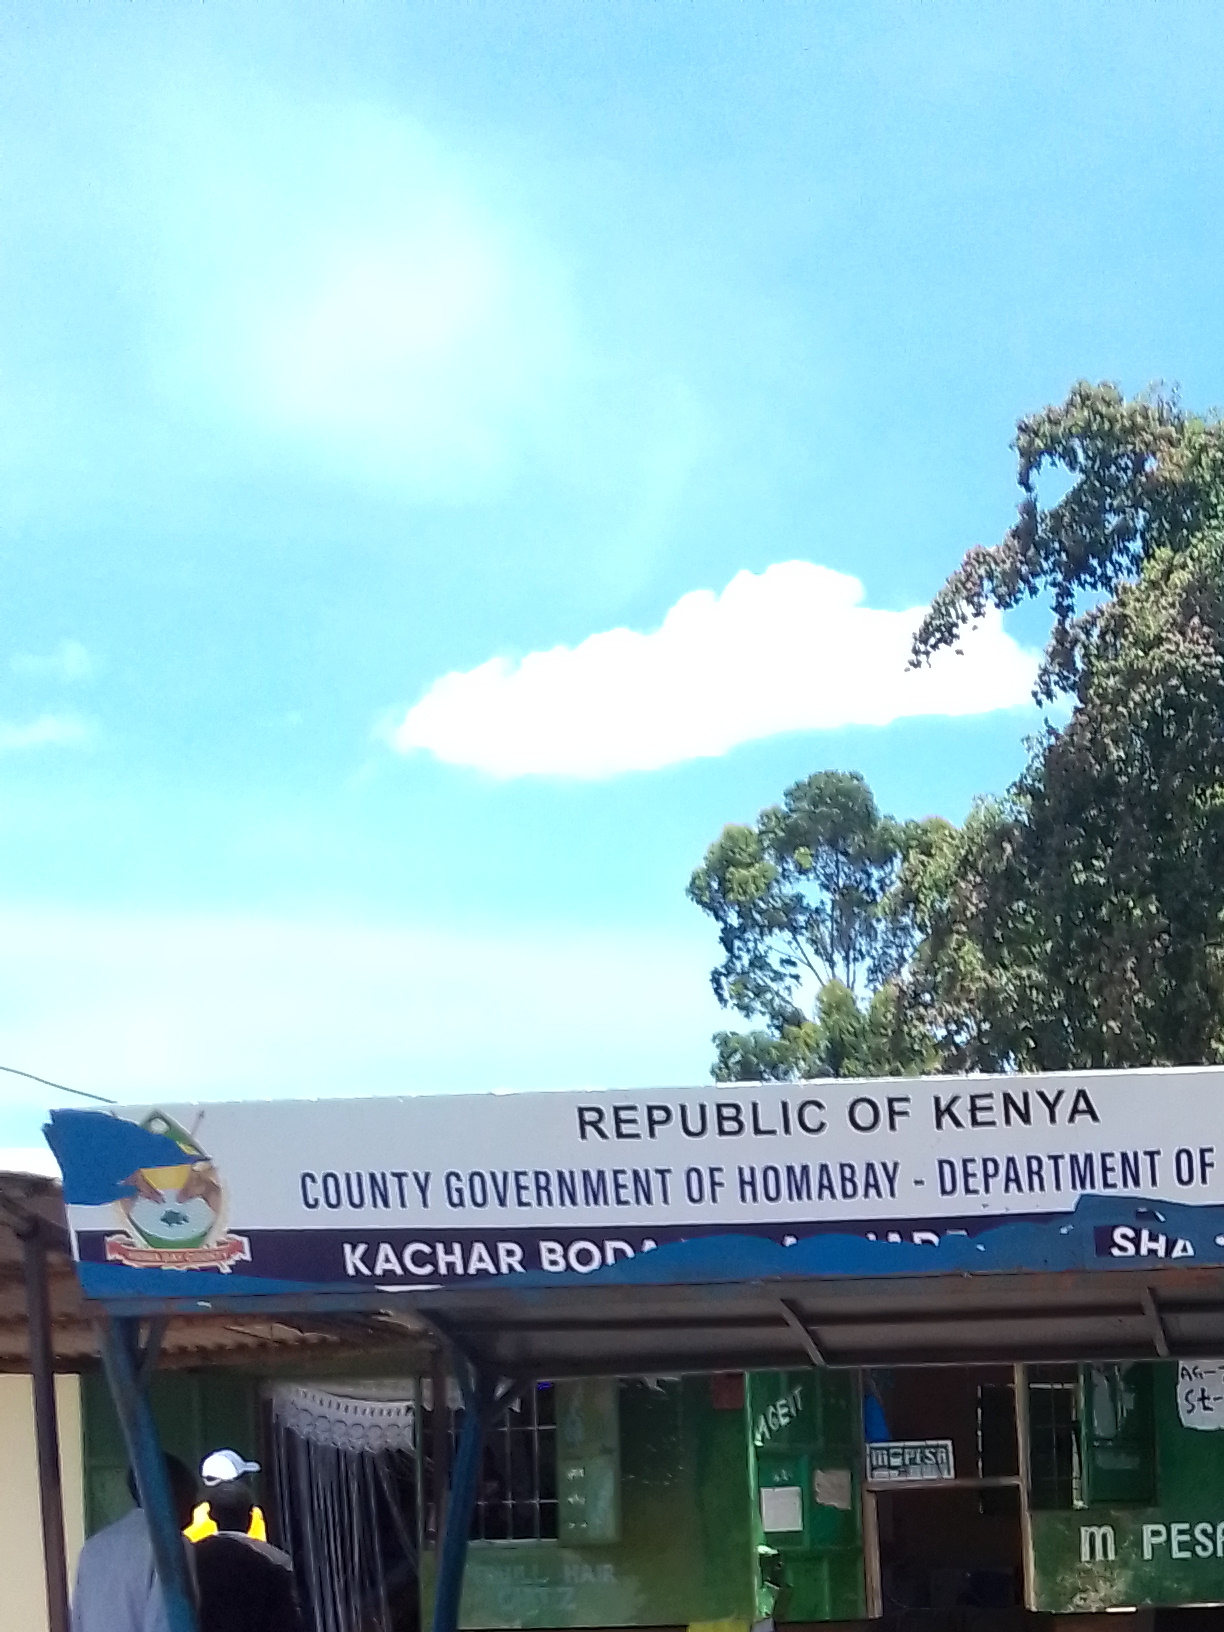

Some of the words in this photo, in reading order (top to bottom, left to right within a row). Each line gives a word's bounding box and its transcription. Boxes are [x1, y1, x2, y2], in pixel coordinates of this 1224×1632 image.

[578, 1097, 828, 1142] REPUBLIC
[847, 1095, 912, 1135] OF
[933, 1087, 1101, 1132] KENYA
[302, 1171, 432, 1211] COUNTY
[445, 1167, 673, 1210] GOVERNMENT
[685, 1165, 725, 1204] OF
[738, 1160, 901, 1203] HOMABAY
[938, 1149, 1162, 1197] DEPARTMENT
[1175, 1145, 1215, 1188] OF
[343, 1240, 527, 1277] KACHAR
